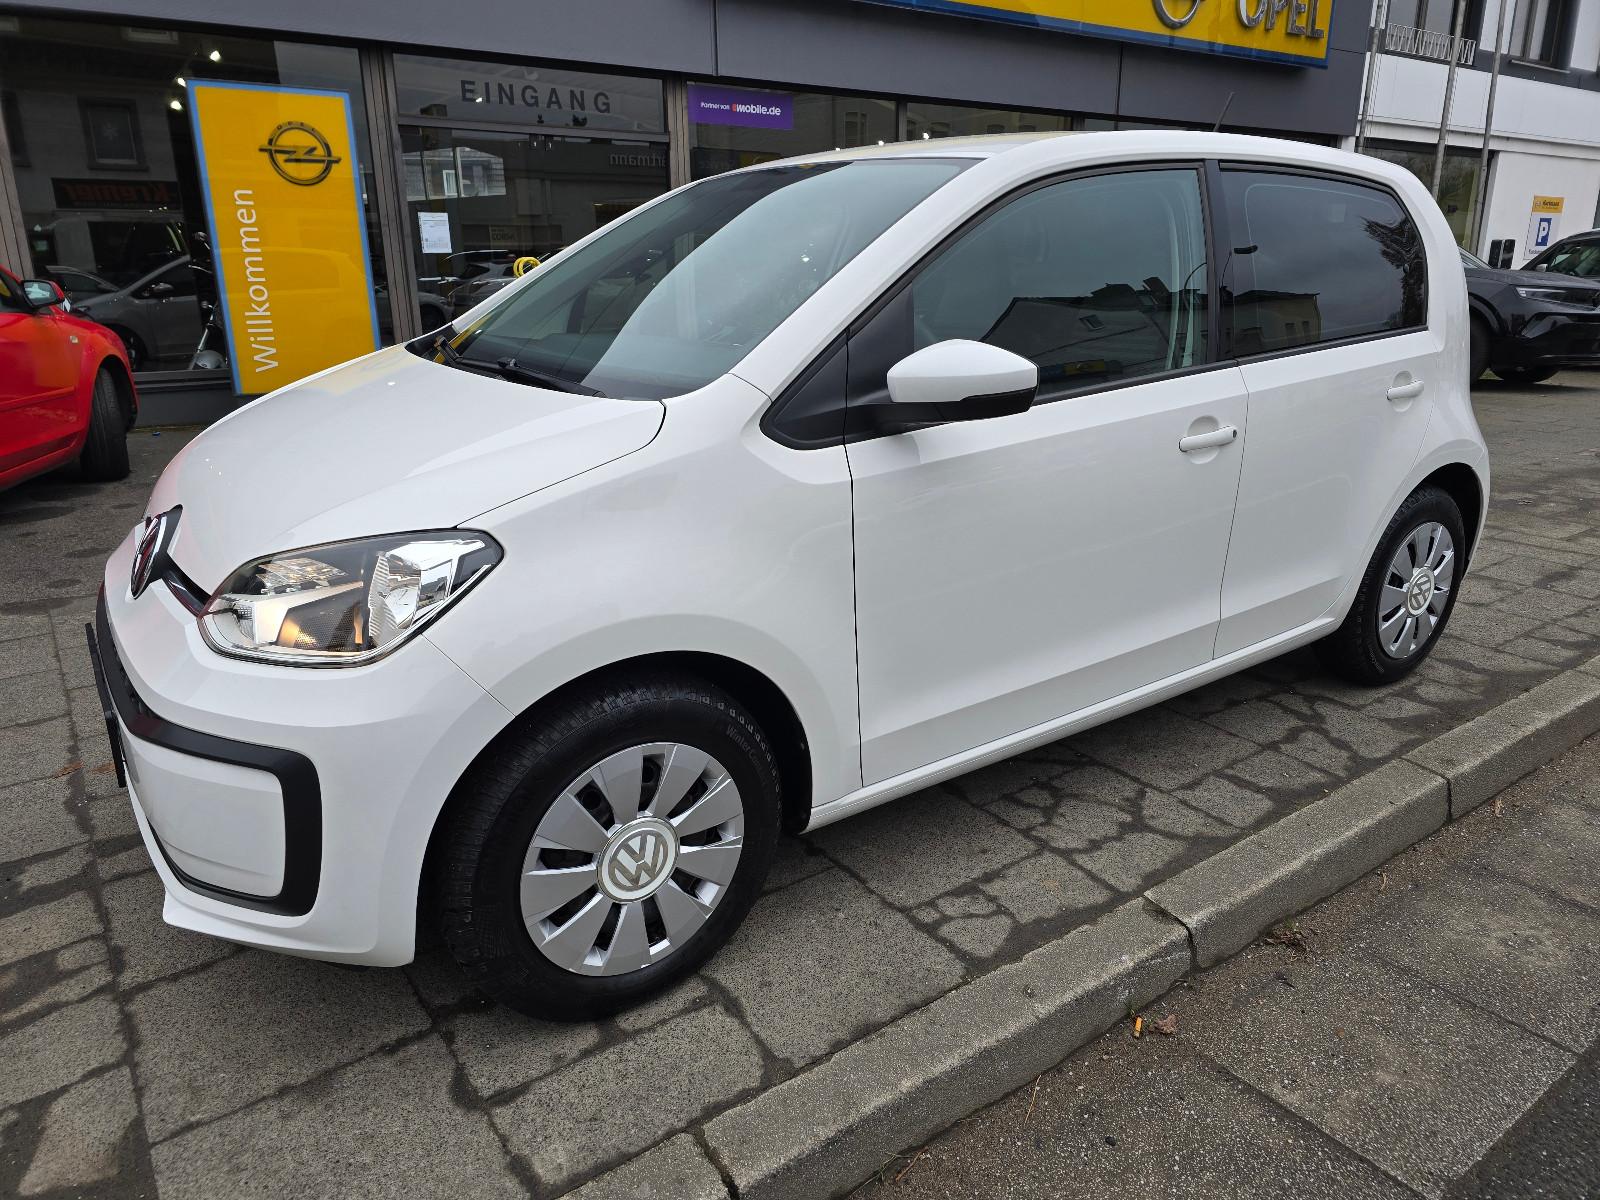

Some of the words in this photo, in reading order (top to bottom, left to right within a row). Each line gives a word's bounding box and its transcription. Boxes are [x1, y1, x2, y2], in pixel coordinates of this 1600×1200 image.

[1238, 0, 1324, 38] OPEL
[460, 79, 611, 114] EINGANG
[700, 101, 720, 109] Partner
[736, 103, 781, 115] mobile.de
